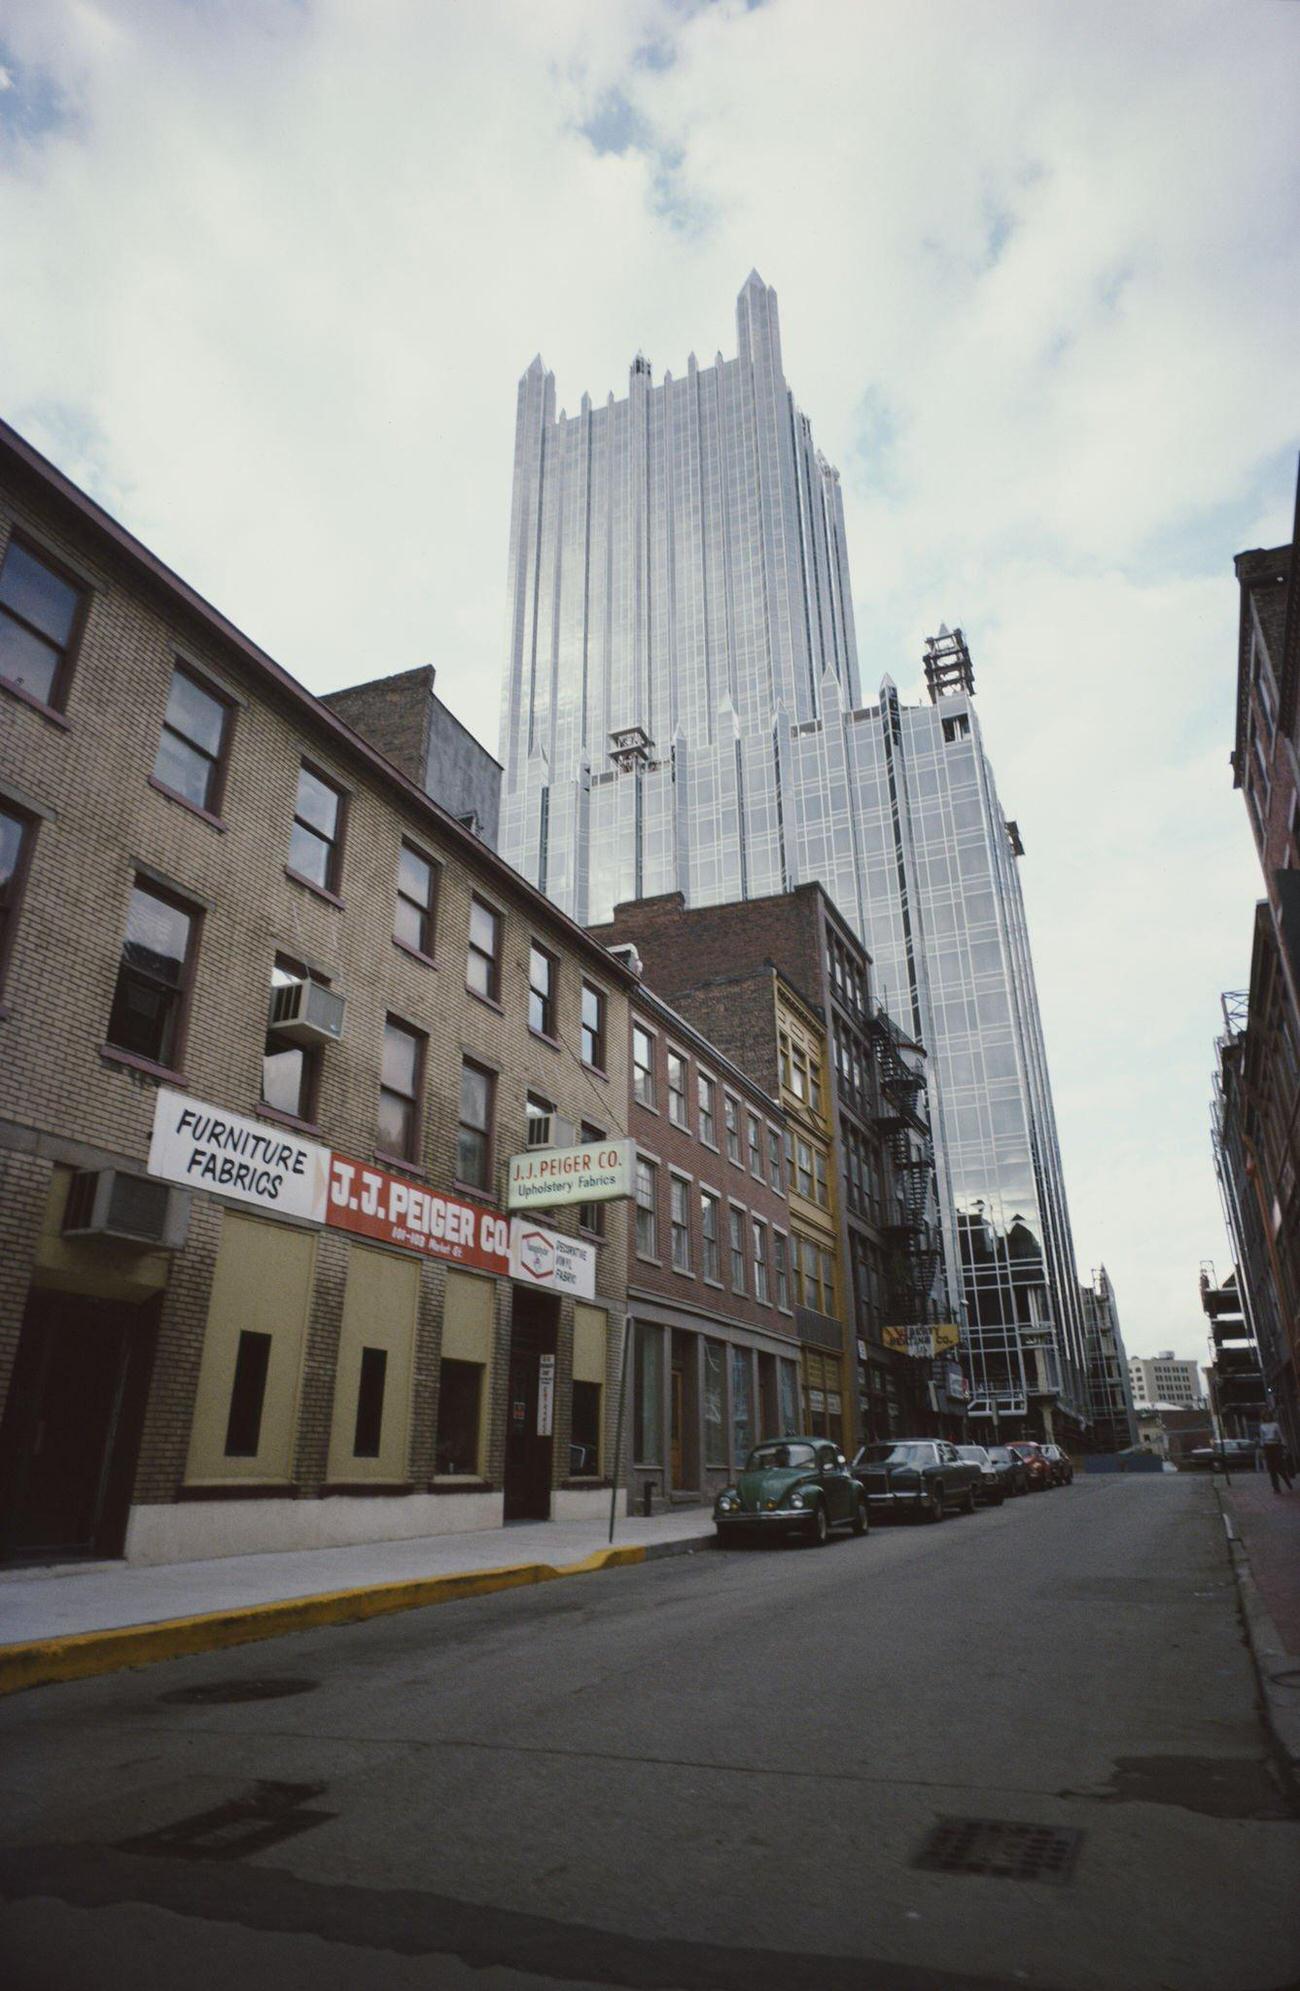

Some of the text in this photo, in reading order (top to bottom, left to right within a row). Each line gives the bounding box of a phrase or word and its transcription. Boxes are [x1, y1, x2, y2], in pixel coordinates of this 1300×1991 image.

[175, 1109, 308, 1175] FURNITURE
[598, 1150, 623, 1169] CO.
[186, 1148, 284, 1200] FABRICS
[518, 1174, 617, 1199] Upholstery Fabrics
